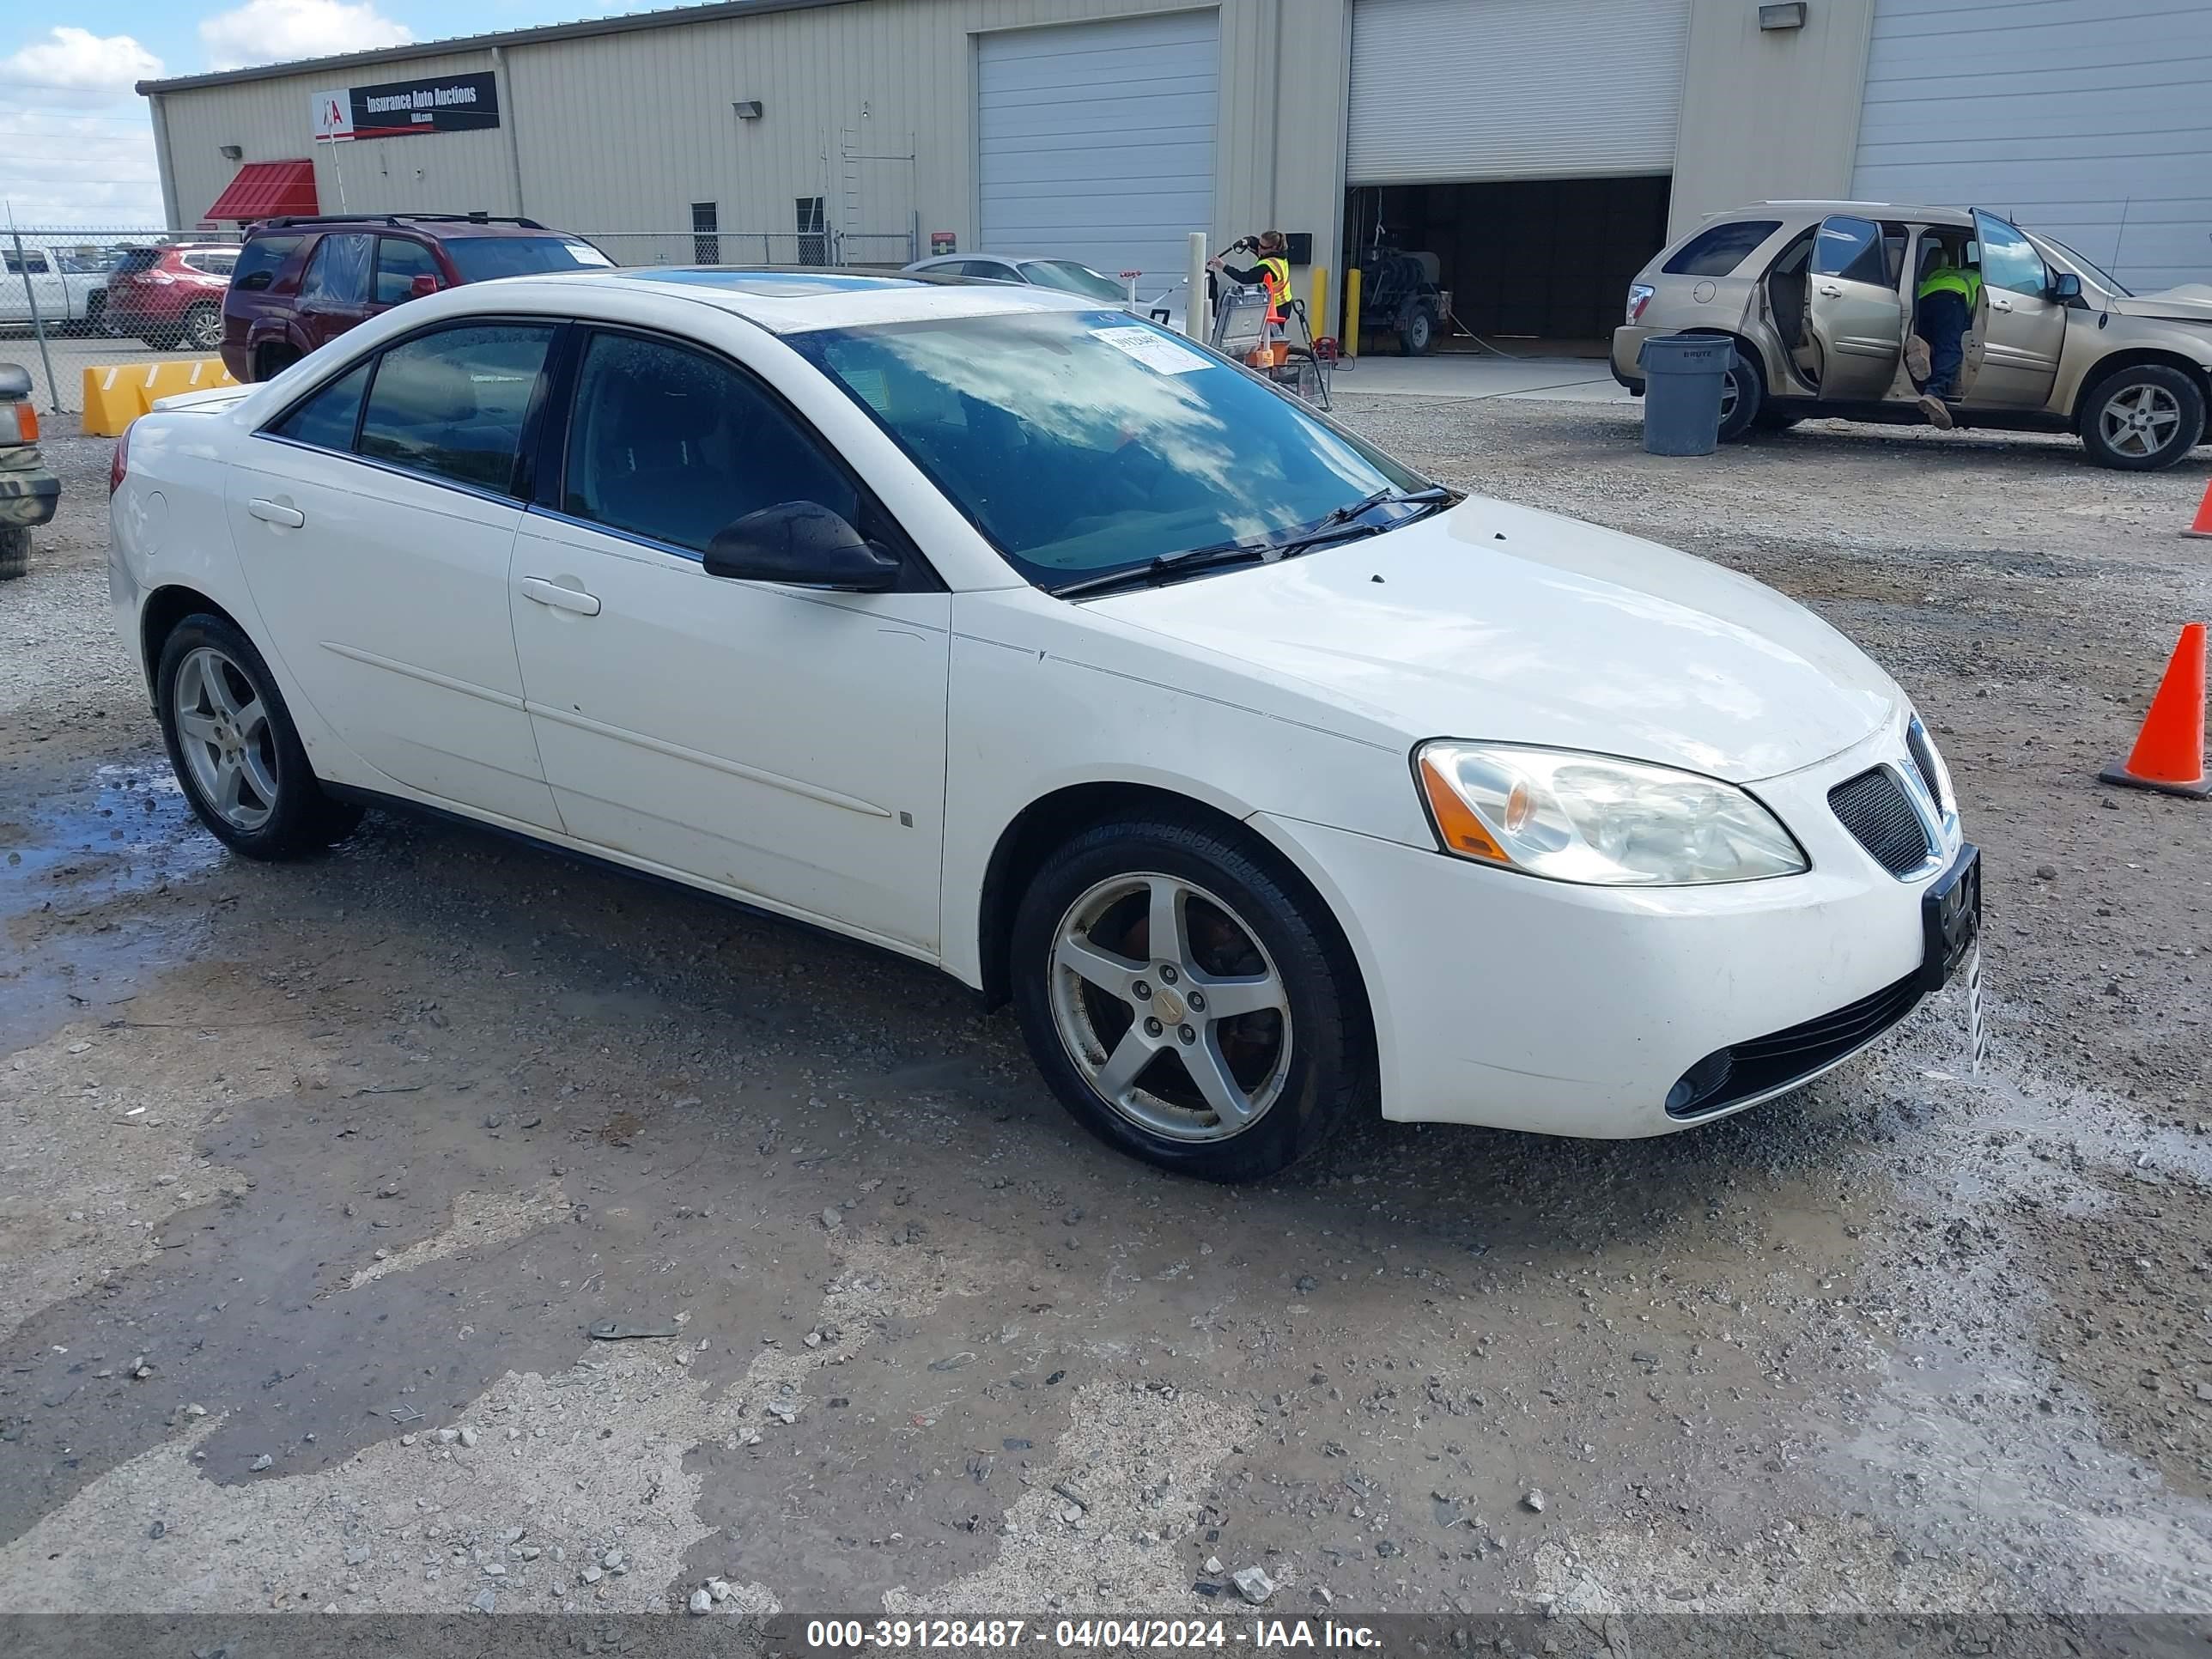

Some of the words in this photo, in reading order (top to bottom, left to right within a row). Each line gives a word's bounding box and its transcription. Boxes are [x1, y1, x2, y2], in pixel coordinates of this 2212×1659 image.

[367, 94, 411, 112] Insurance
[412, 90, 434, 108] Auto
[434, 86, 476, 106] Auctions
